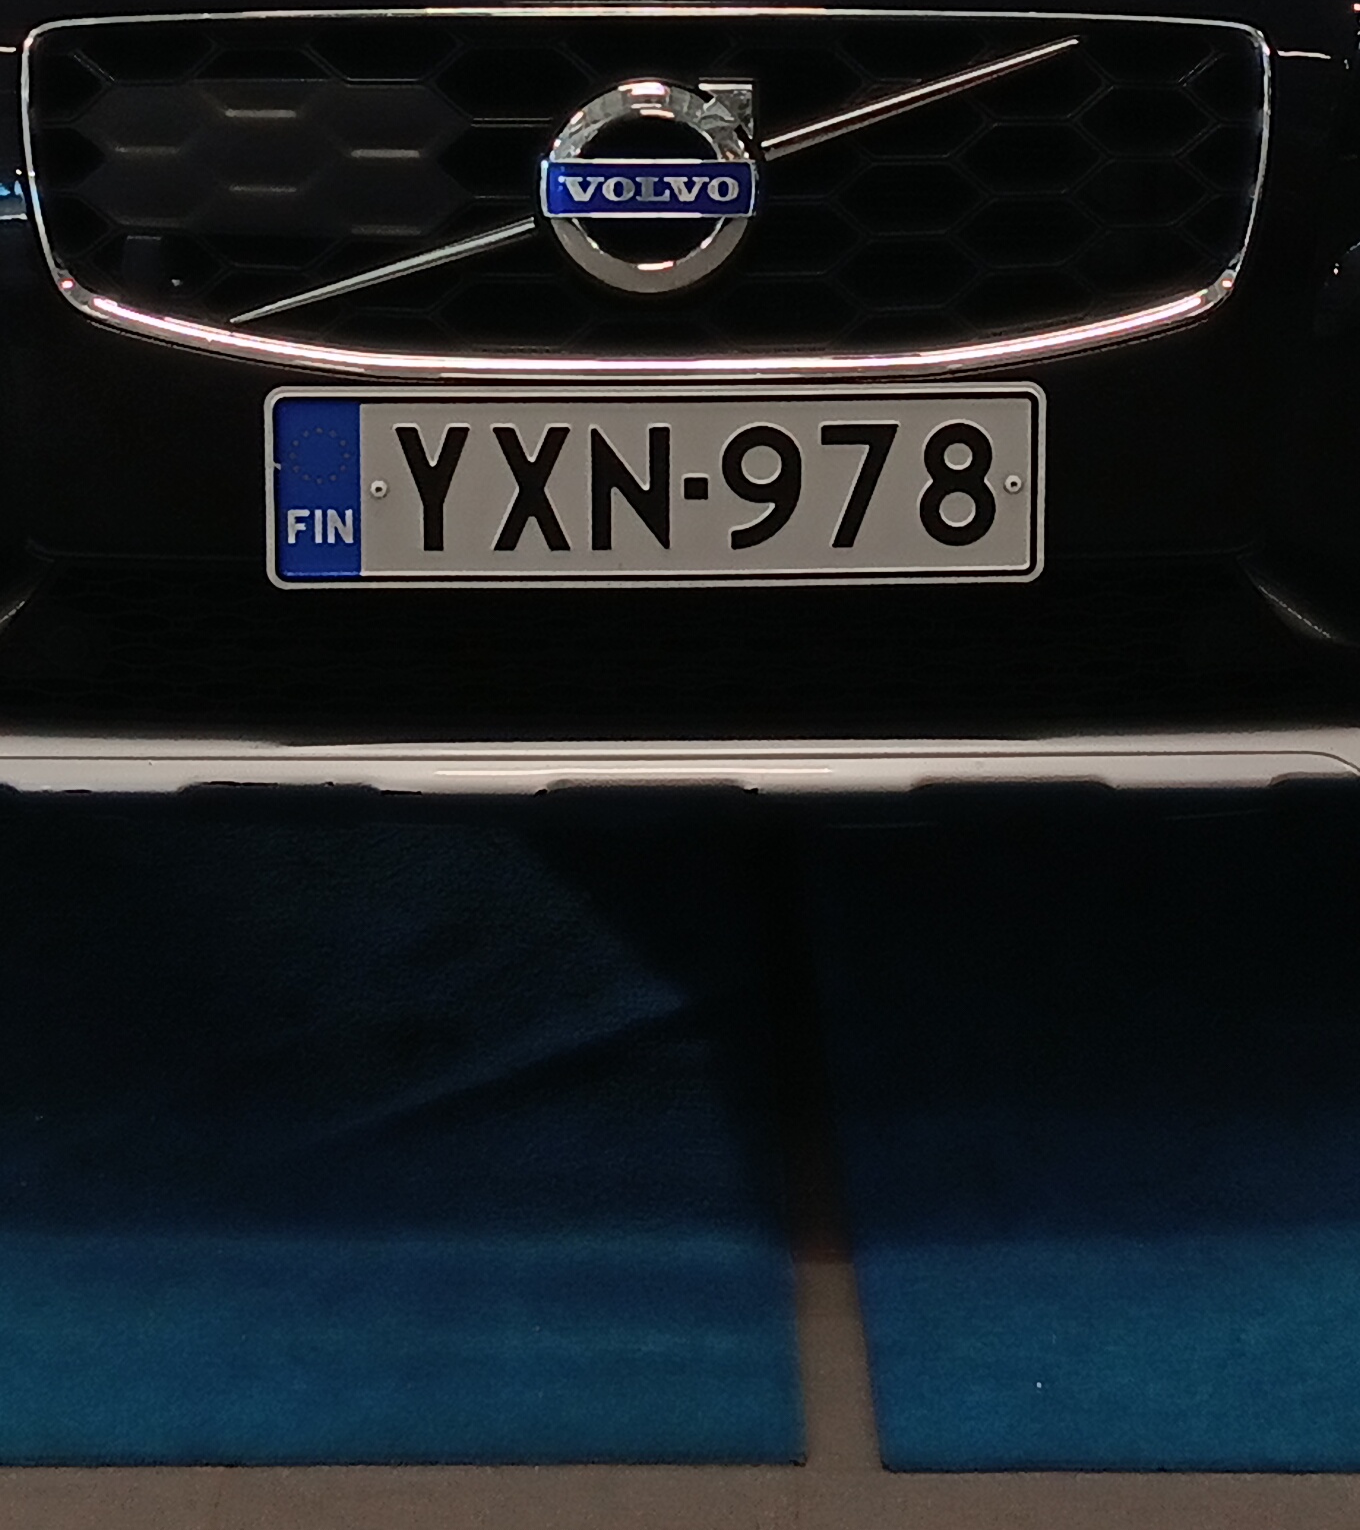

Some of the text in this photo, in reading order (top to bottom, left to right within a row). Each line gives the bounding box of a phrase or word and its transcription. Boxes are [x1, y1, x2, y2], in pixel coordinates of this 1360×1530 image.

[562, 175, 740, 203] VOLVO
[393, 421, 997, 553] YXN-978
[285, 507, 355, 546] FIN
